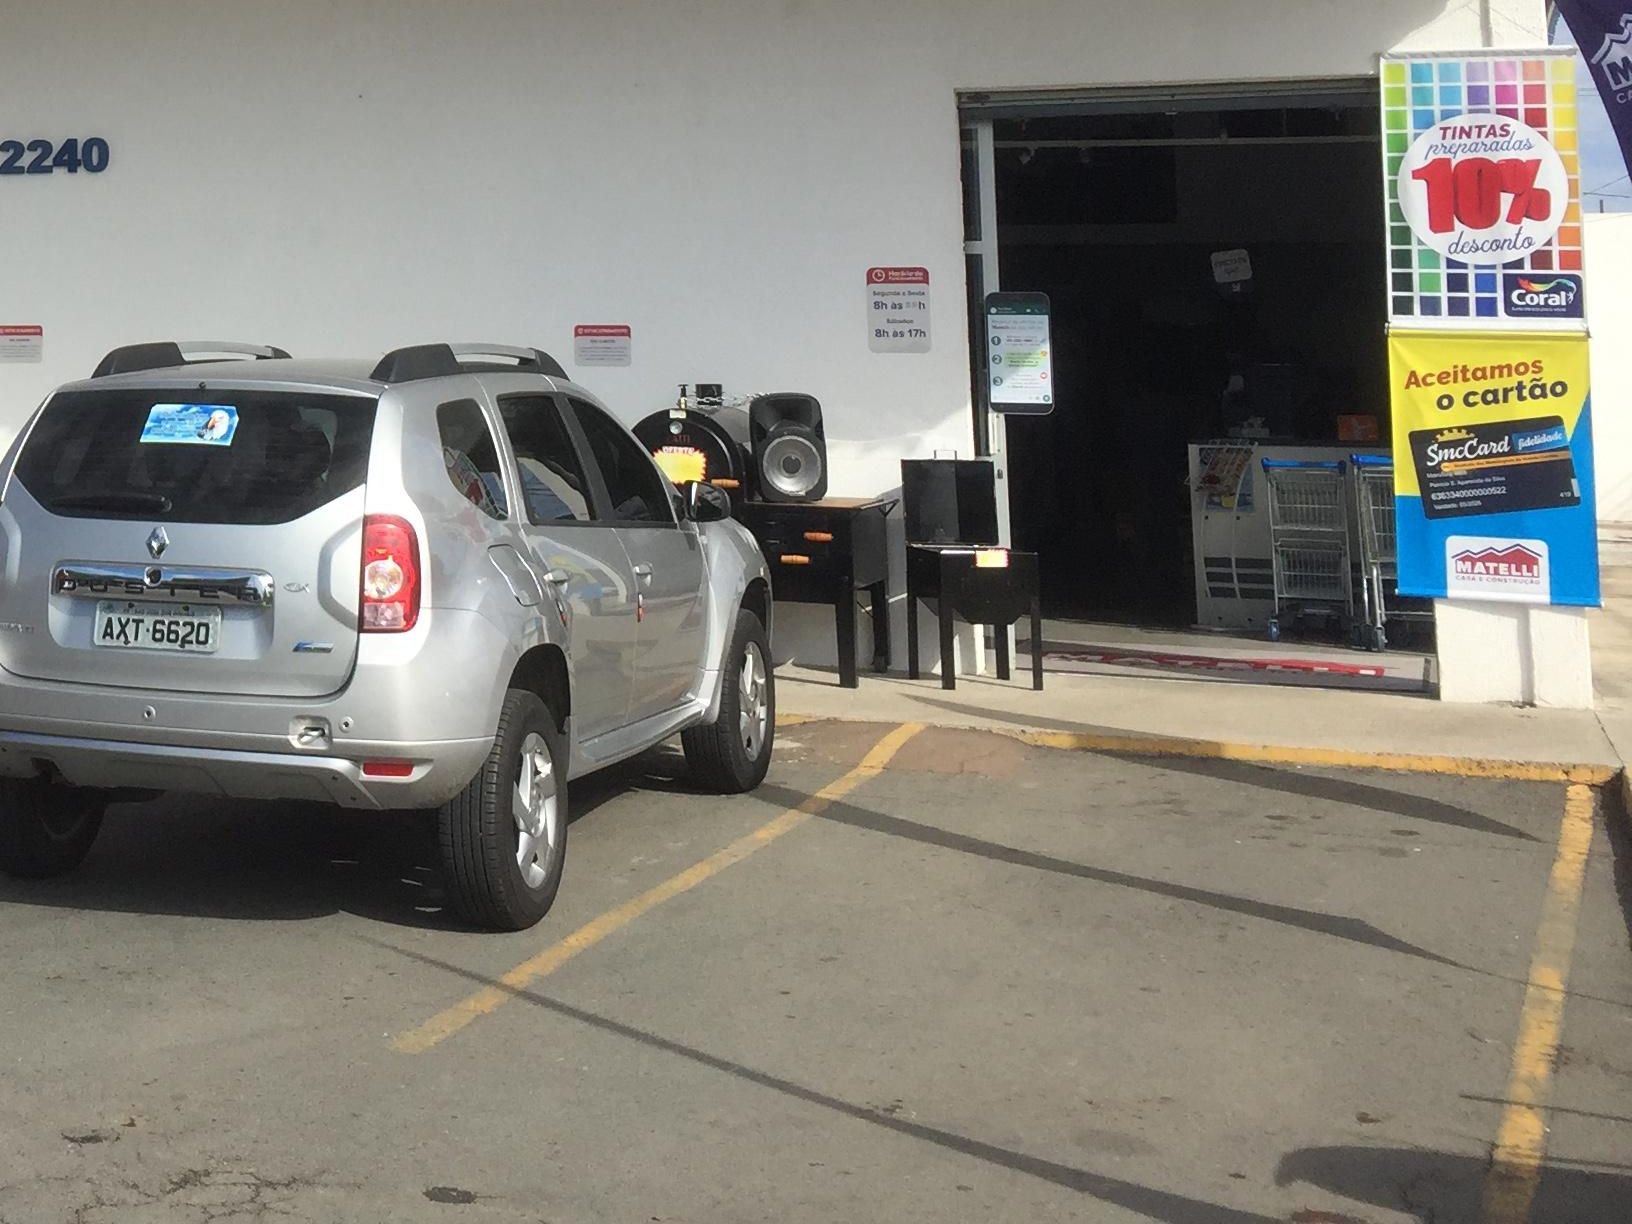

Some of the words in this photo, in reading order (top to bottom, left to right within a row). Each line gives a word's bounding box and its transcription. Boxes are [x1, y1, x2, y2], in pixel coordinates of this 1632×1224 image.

[1424, 131, 1535, 160] preparadas
[1439, 123, 1512, 141] TINTAS
[1411, 157, 1552, 234] 10%
[1448, 227, 1536, 255] desconto
[1511, 288, 1567, 306] Coral
[1404, 359, 1544, 390] Aceitamos
[1436, 394, 1454, 410] o
[1462, 378, 1568, 408] cartão
[1426, 436, 1511, 466] SmcCard
[1456, 560, 1539, 576] MATELLI
